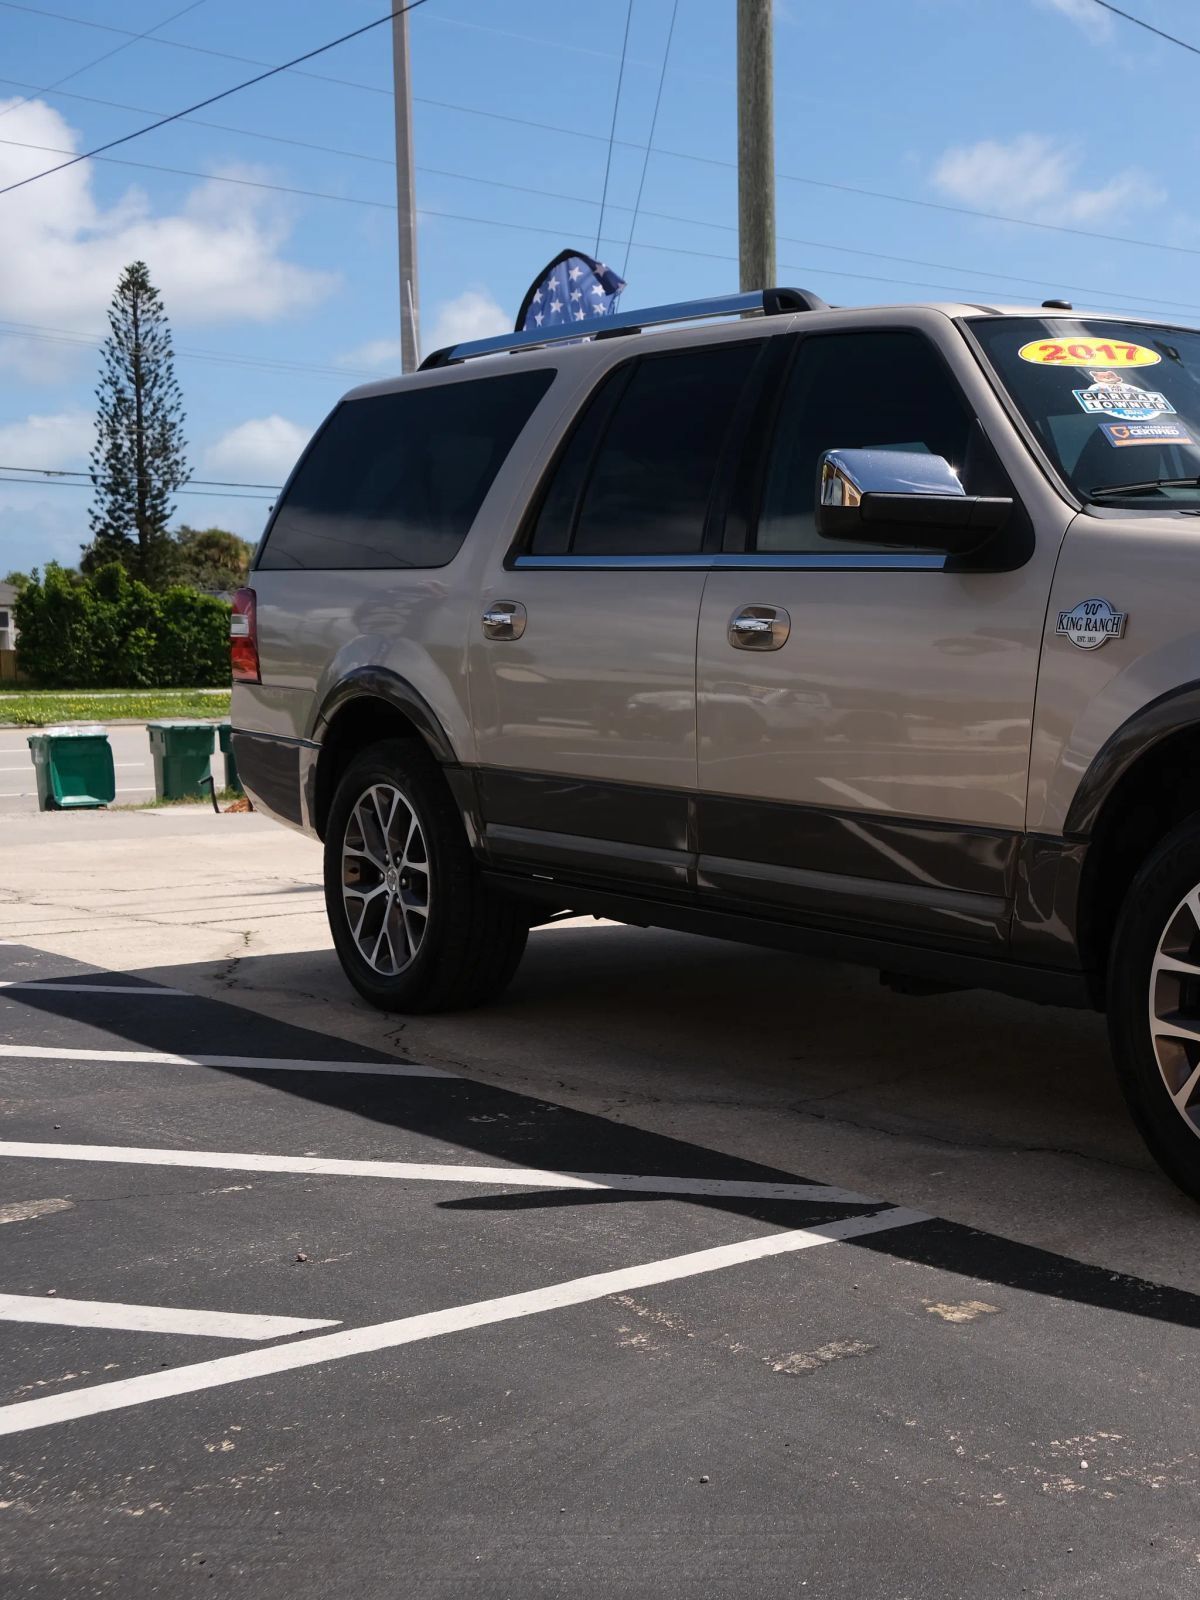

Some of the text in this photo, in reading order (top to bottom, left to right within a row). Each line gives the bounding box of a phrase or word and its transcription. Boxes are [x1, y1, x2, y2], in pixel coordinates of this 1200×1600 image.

[1039, 344, 1138, 361] 2017
[1102, 401, 1168, 410] OWNER
[1130, 428, 1180, 436] CERTIFIED
[1058, 614, 1121, 633] KING RANCH
